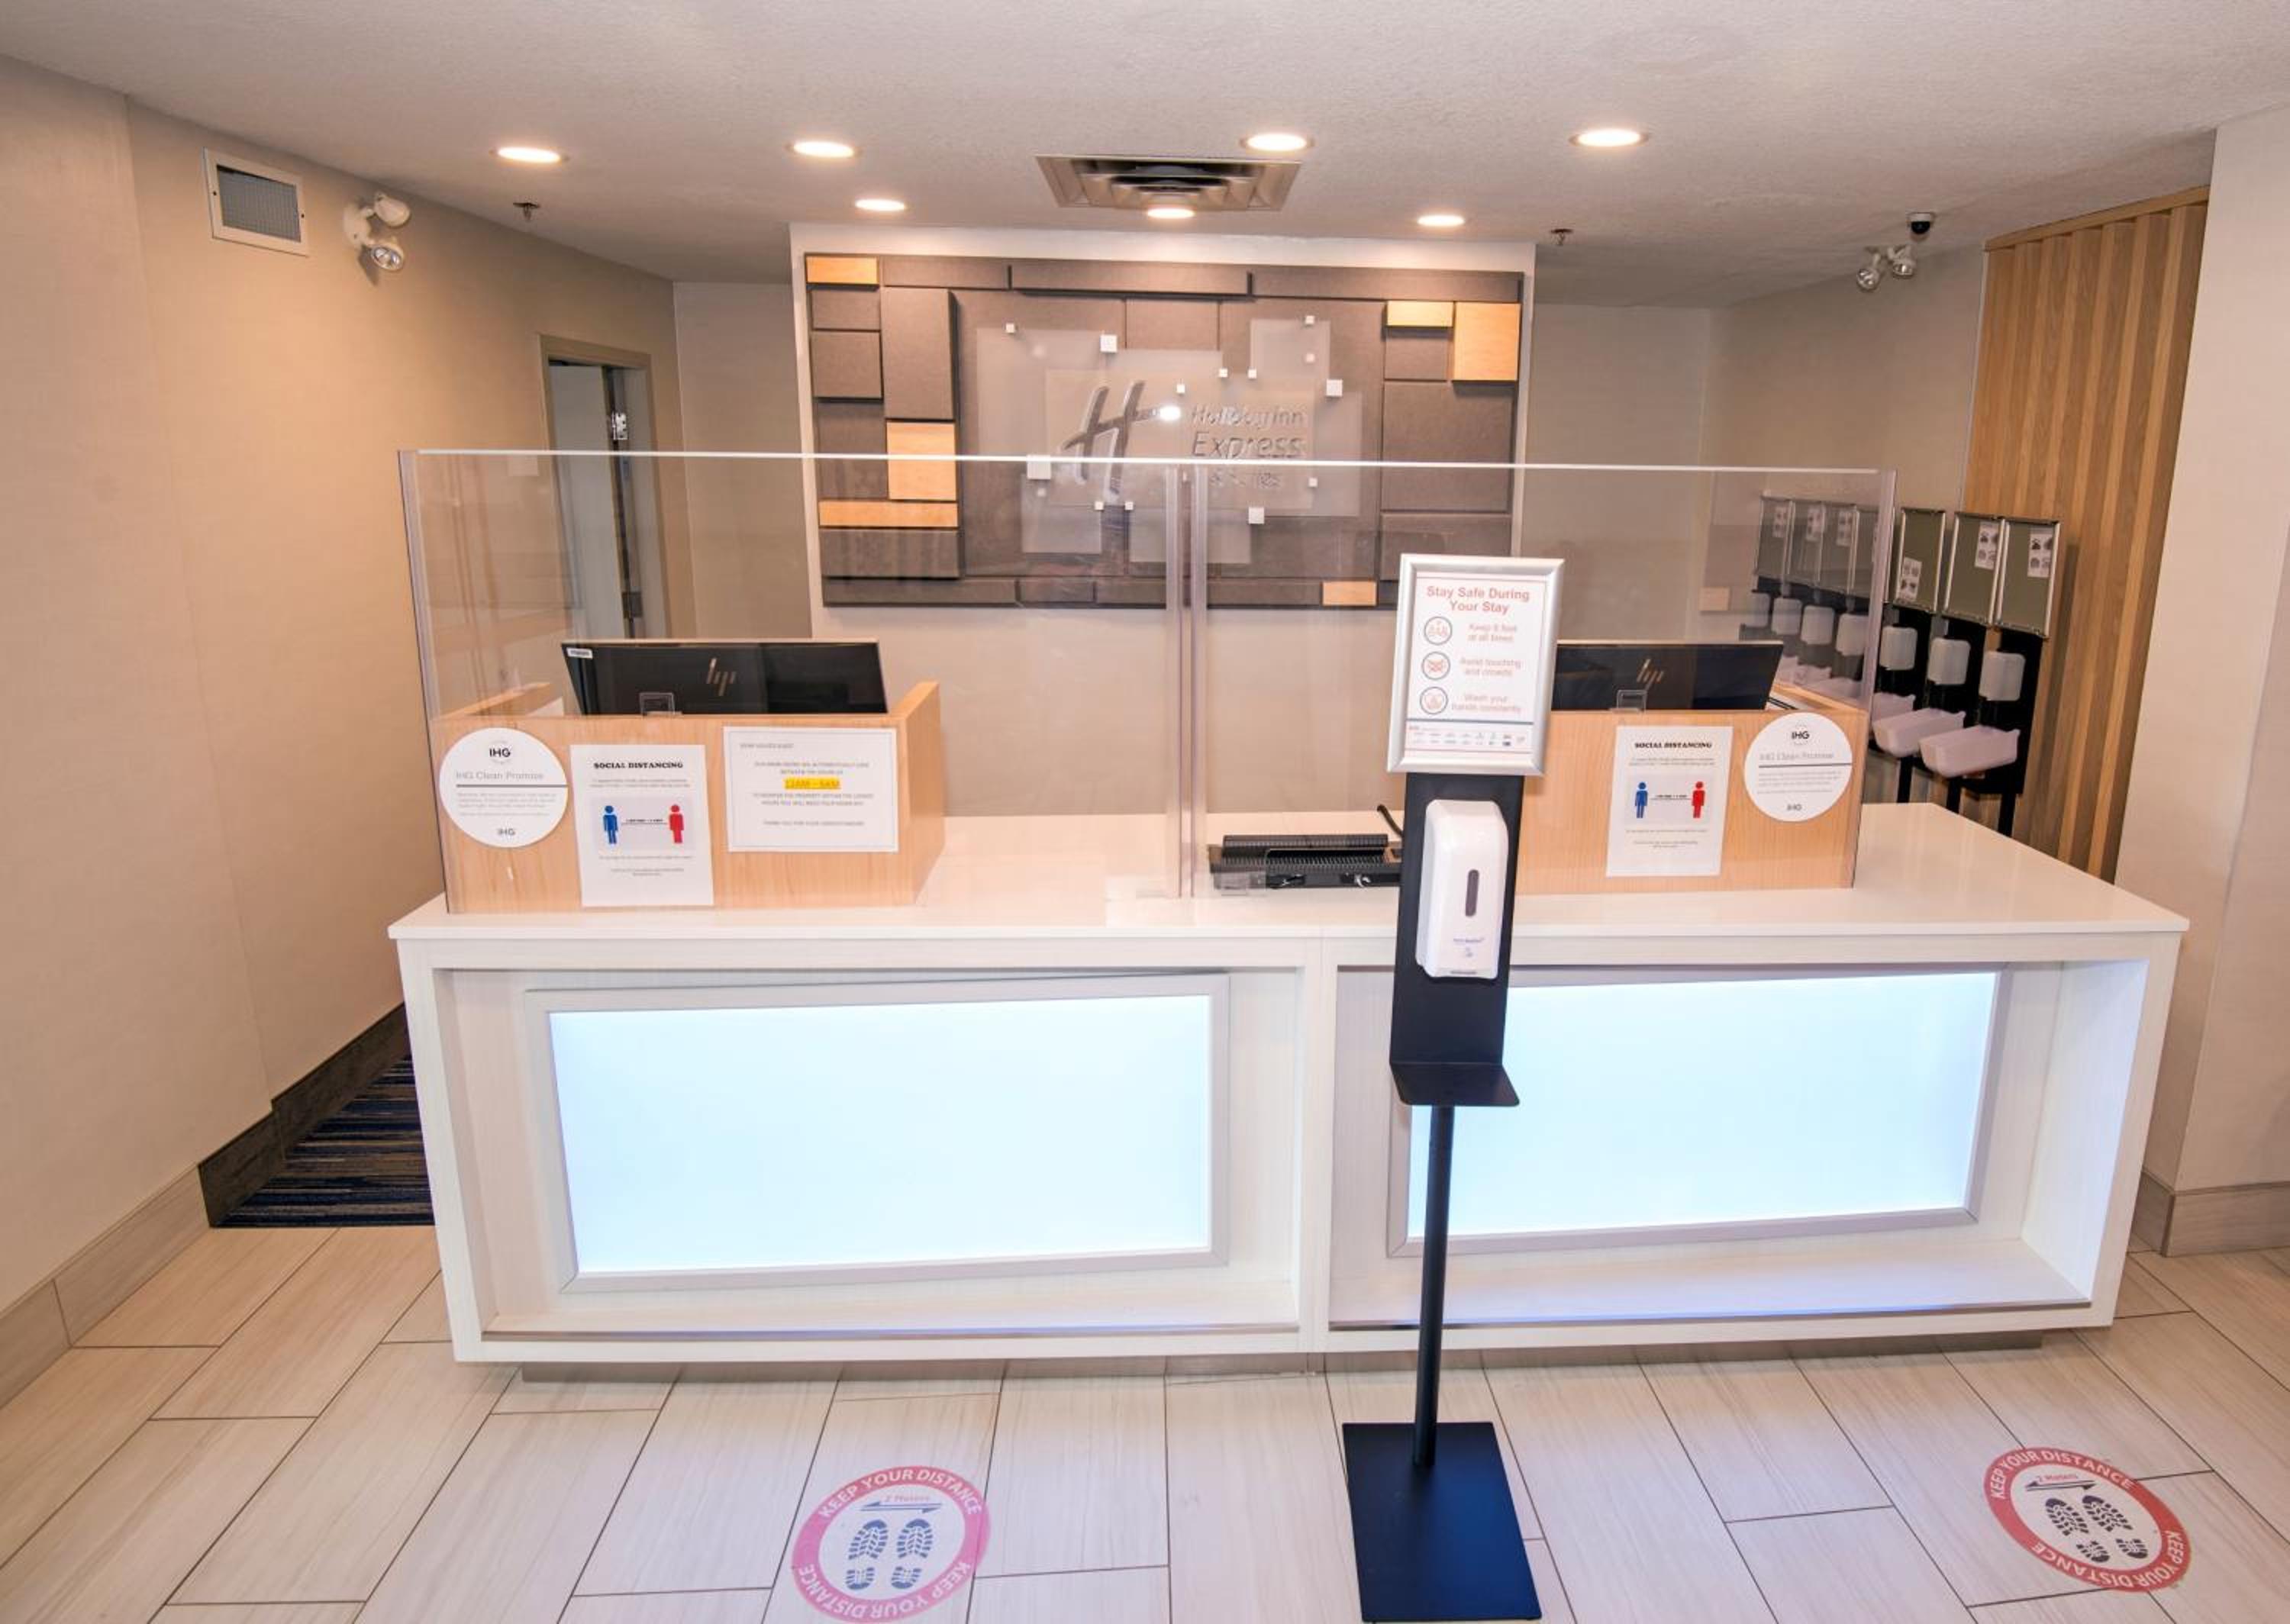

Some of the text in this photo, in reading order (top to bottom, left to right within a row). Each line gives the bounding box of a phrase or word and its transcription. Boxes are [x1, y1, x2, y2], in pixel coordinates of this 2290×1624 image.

[1192, 430, 1305, 459] Express
[1426, 585, 1530, 602] Stay Safe During
[1450, 600, 1510, 615] Your Stay
[705, 657, 737, 697] hp
[1637, 659, 1664, 691] hp
[1791, 730, 1810, 740] IHG
[489, 747, 511, 758] IHG
[476, 771, 503, 780] Clean
[1989, 1450, 2137, 1500] KEEP YOUR DISTANCE
[818, 1468, 982, 1519] KEEP YOUR DISTANCE
[2031, 1529, 2185, 1588] KEEP YOUR DISTANCE
[798, 1561, 972, 1619] KEEP YOUR DISTANCE
